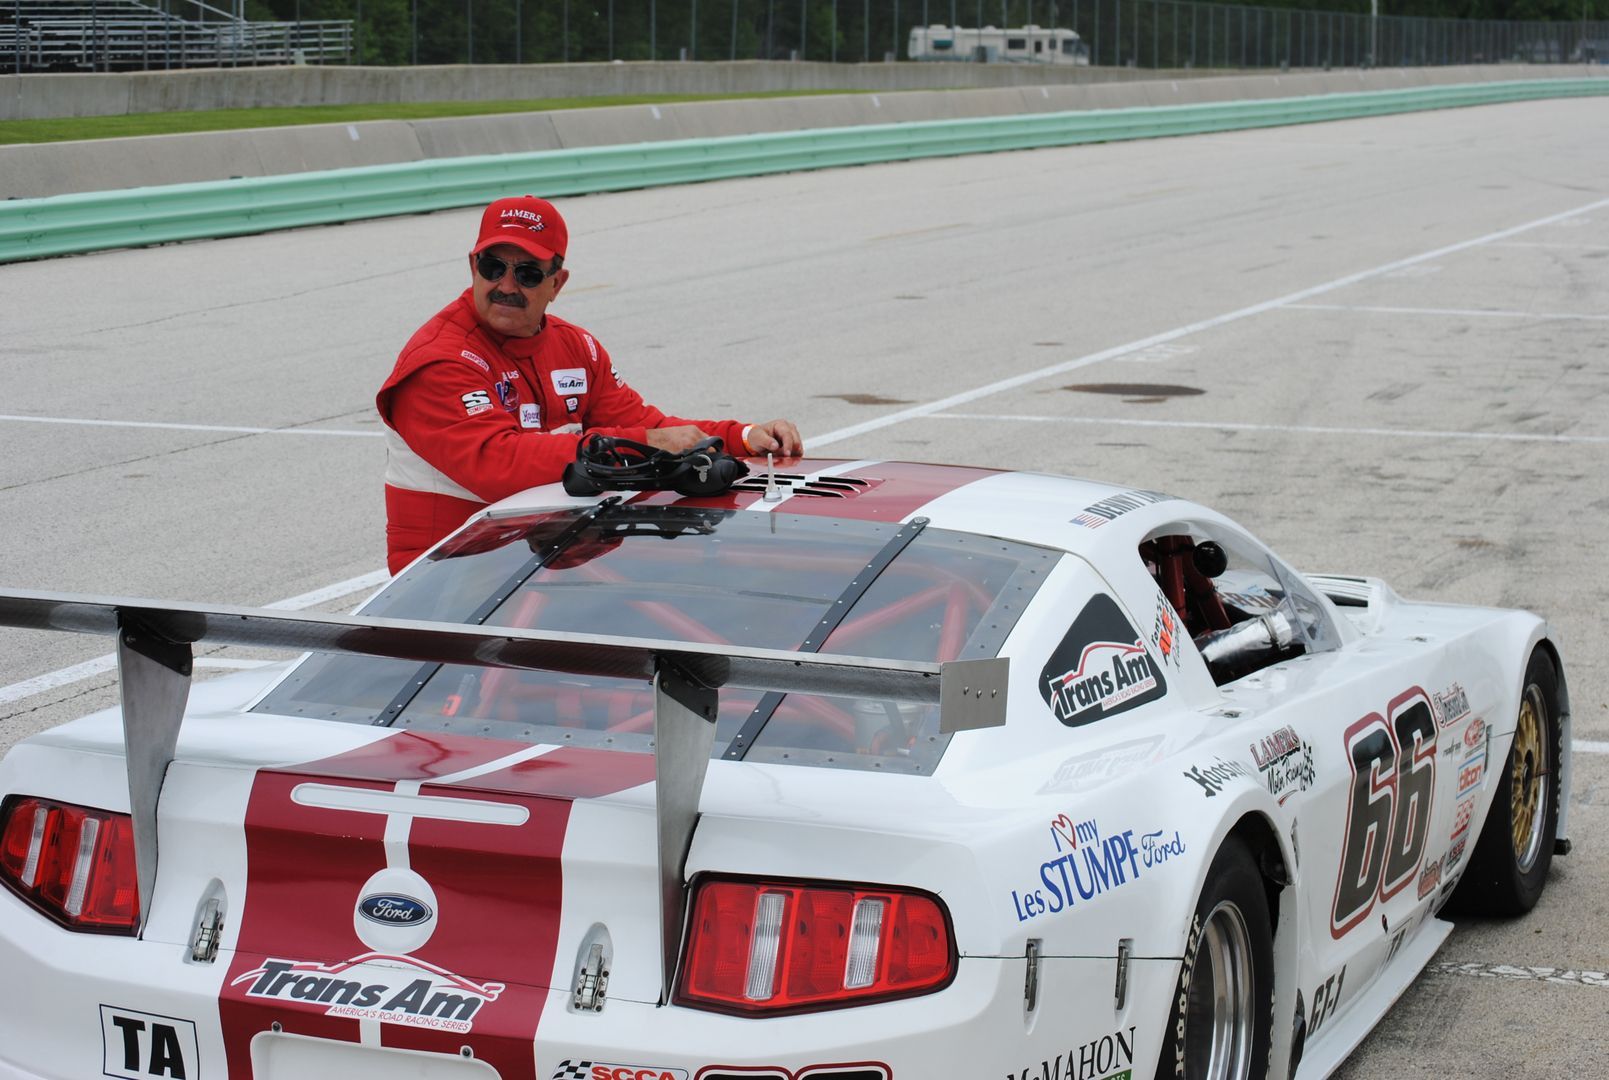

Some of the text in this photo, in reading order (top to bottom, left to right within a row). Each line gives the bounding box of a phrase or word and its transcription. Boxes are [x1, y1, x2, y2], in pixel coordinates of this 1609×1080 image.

[501, 208, 542, 222] LAMERS
[463, 351, 489, 371] SIMPSON
[467, 404, 493, 415] SIMPSON
[1083, 493, 1146, 520] DENNY
[1052, 654, 1151, 716] Trans Am
[1250, 724, 1301, 772] LAMERS
[1330, 684, 1440, 940] 66
[1051, 819, 1100, 852] I my
[1012, 829, 1186, 922] Les STUMPF Ford
[372, 898, 414, 920] Ford
[250, 961, 482, 1021] Trans Am
[330, 1006, 470, 1031] AMERICA'S ROAD RACING SERIES
[112, 1015, 187, 1080] TA
